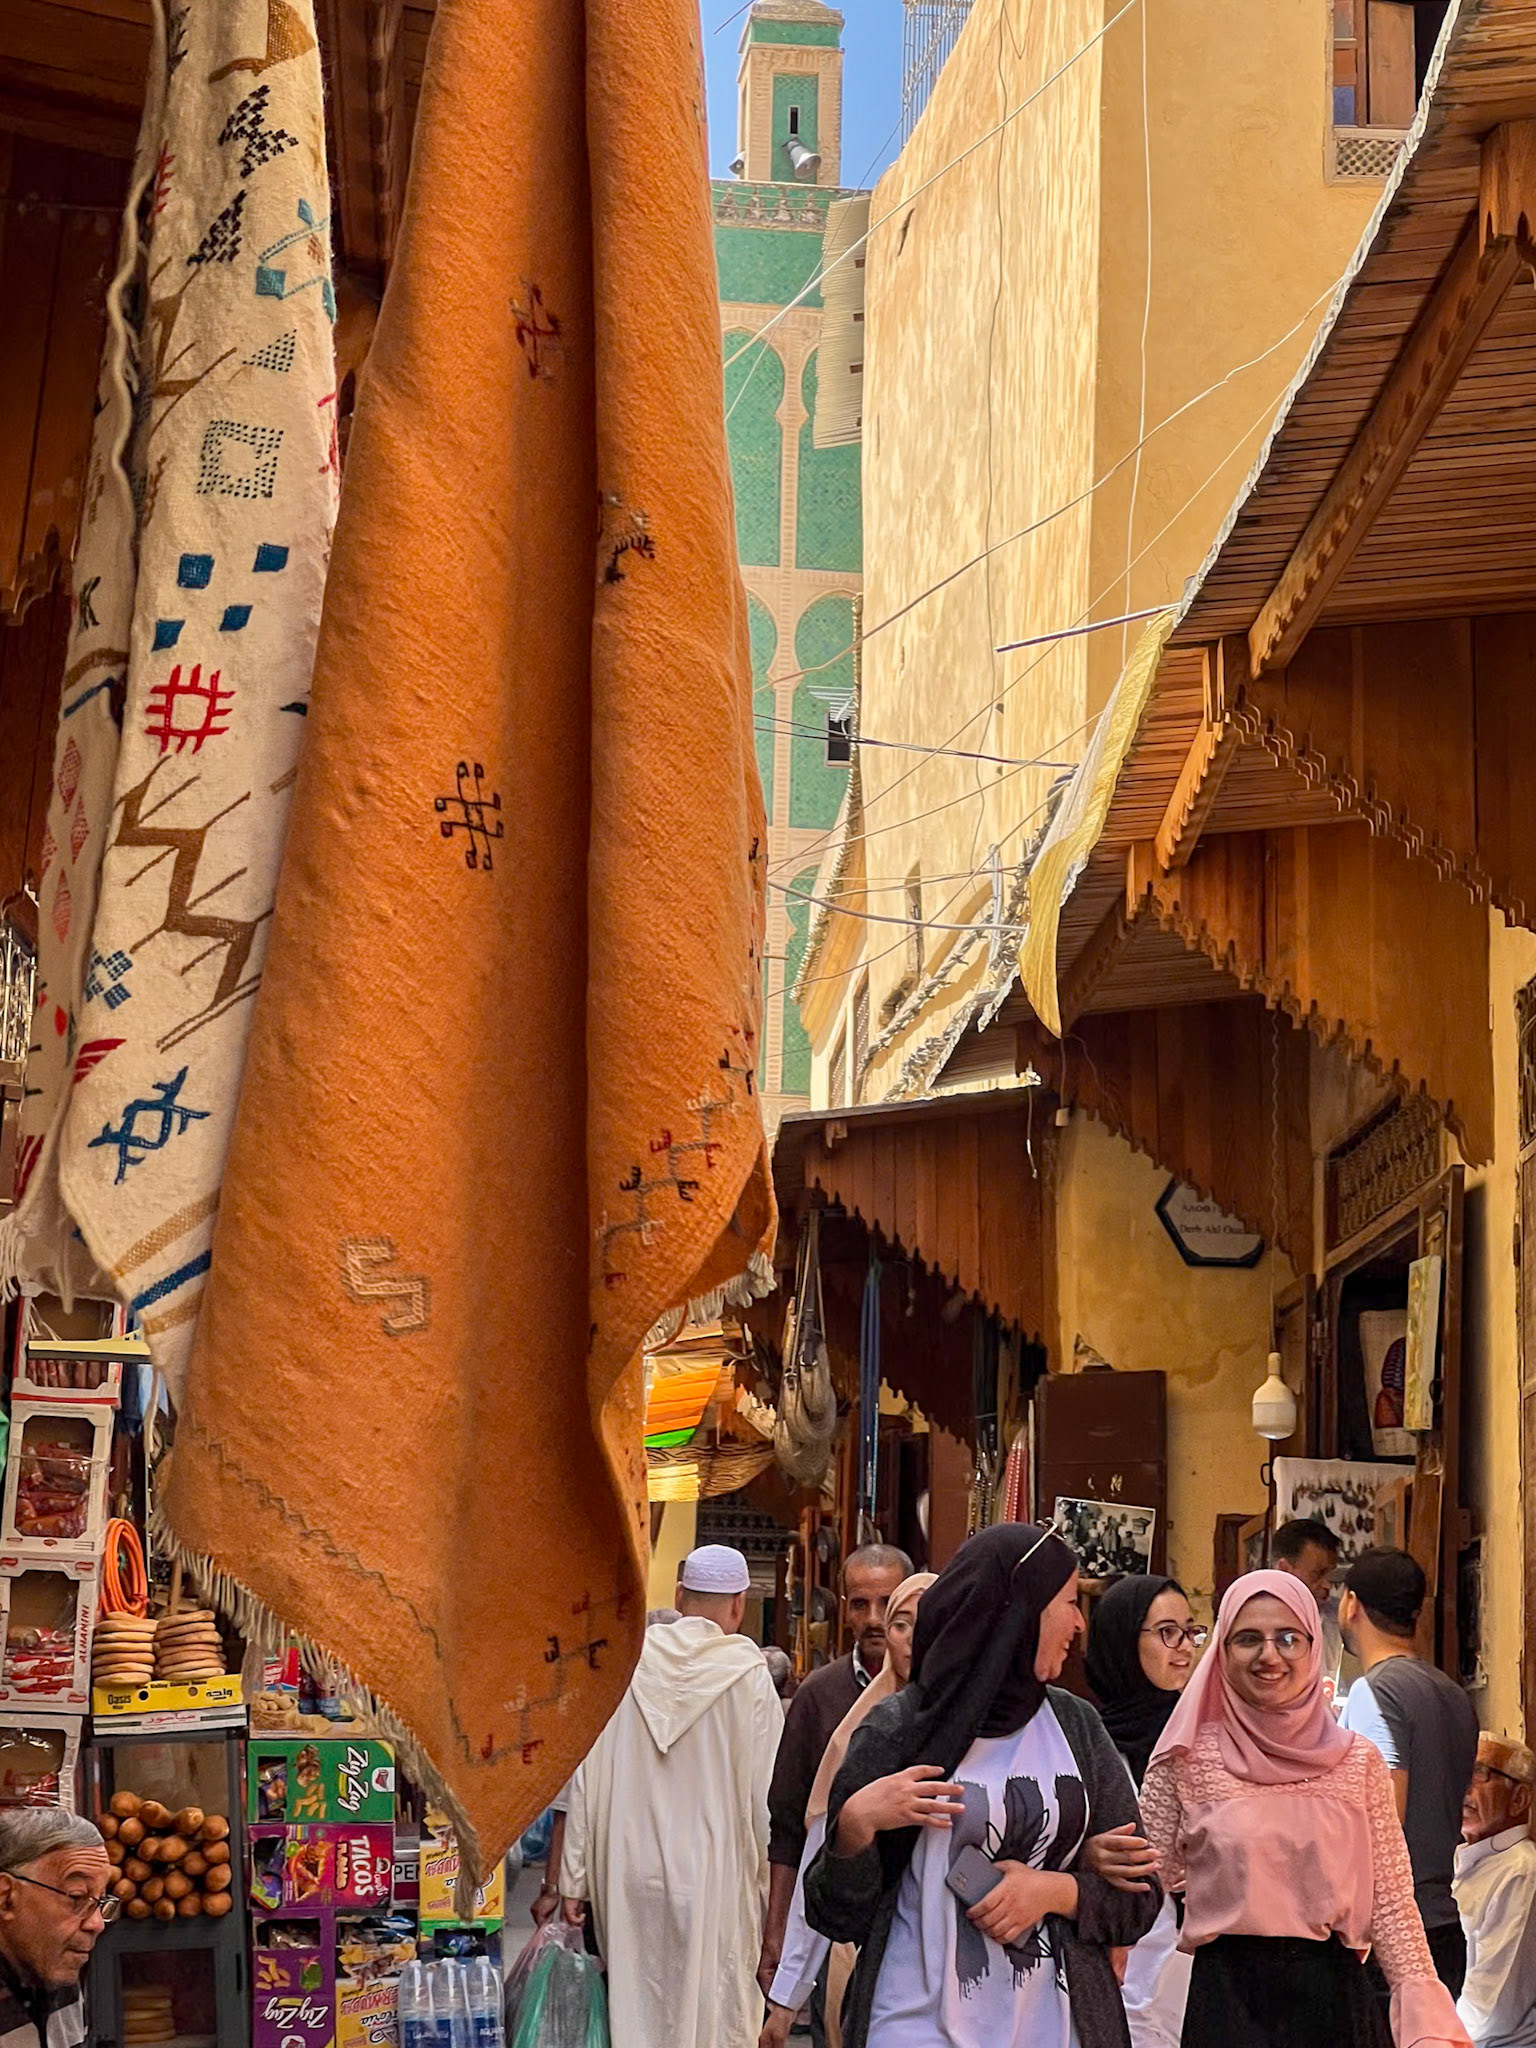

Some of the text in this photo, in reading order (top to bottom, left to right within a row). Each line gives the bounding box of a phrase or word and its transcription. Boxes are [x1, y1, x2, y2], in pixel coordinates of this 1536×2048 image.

[1180, 1224, 1202, 1234] Derb
[1204, 1224, 1220, 1234] Ahl
[79, 1604, 90, 1663] ALHANINI
[107, 1694, 132, 1705] Oasis
[337, 1746, 369, 1777] Zig
[337, 1777, 369, 1813] Zag
[350, 1834, 375, 1897] TACOS
[298, 1996, 329, 2029] Zig
